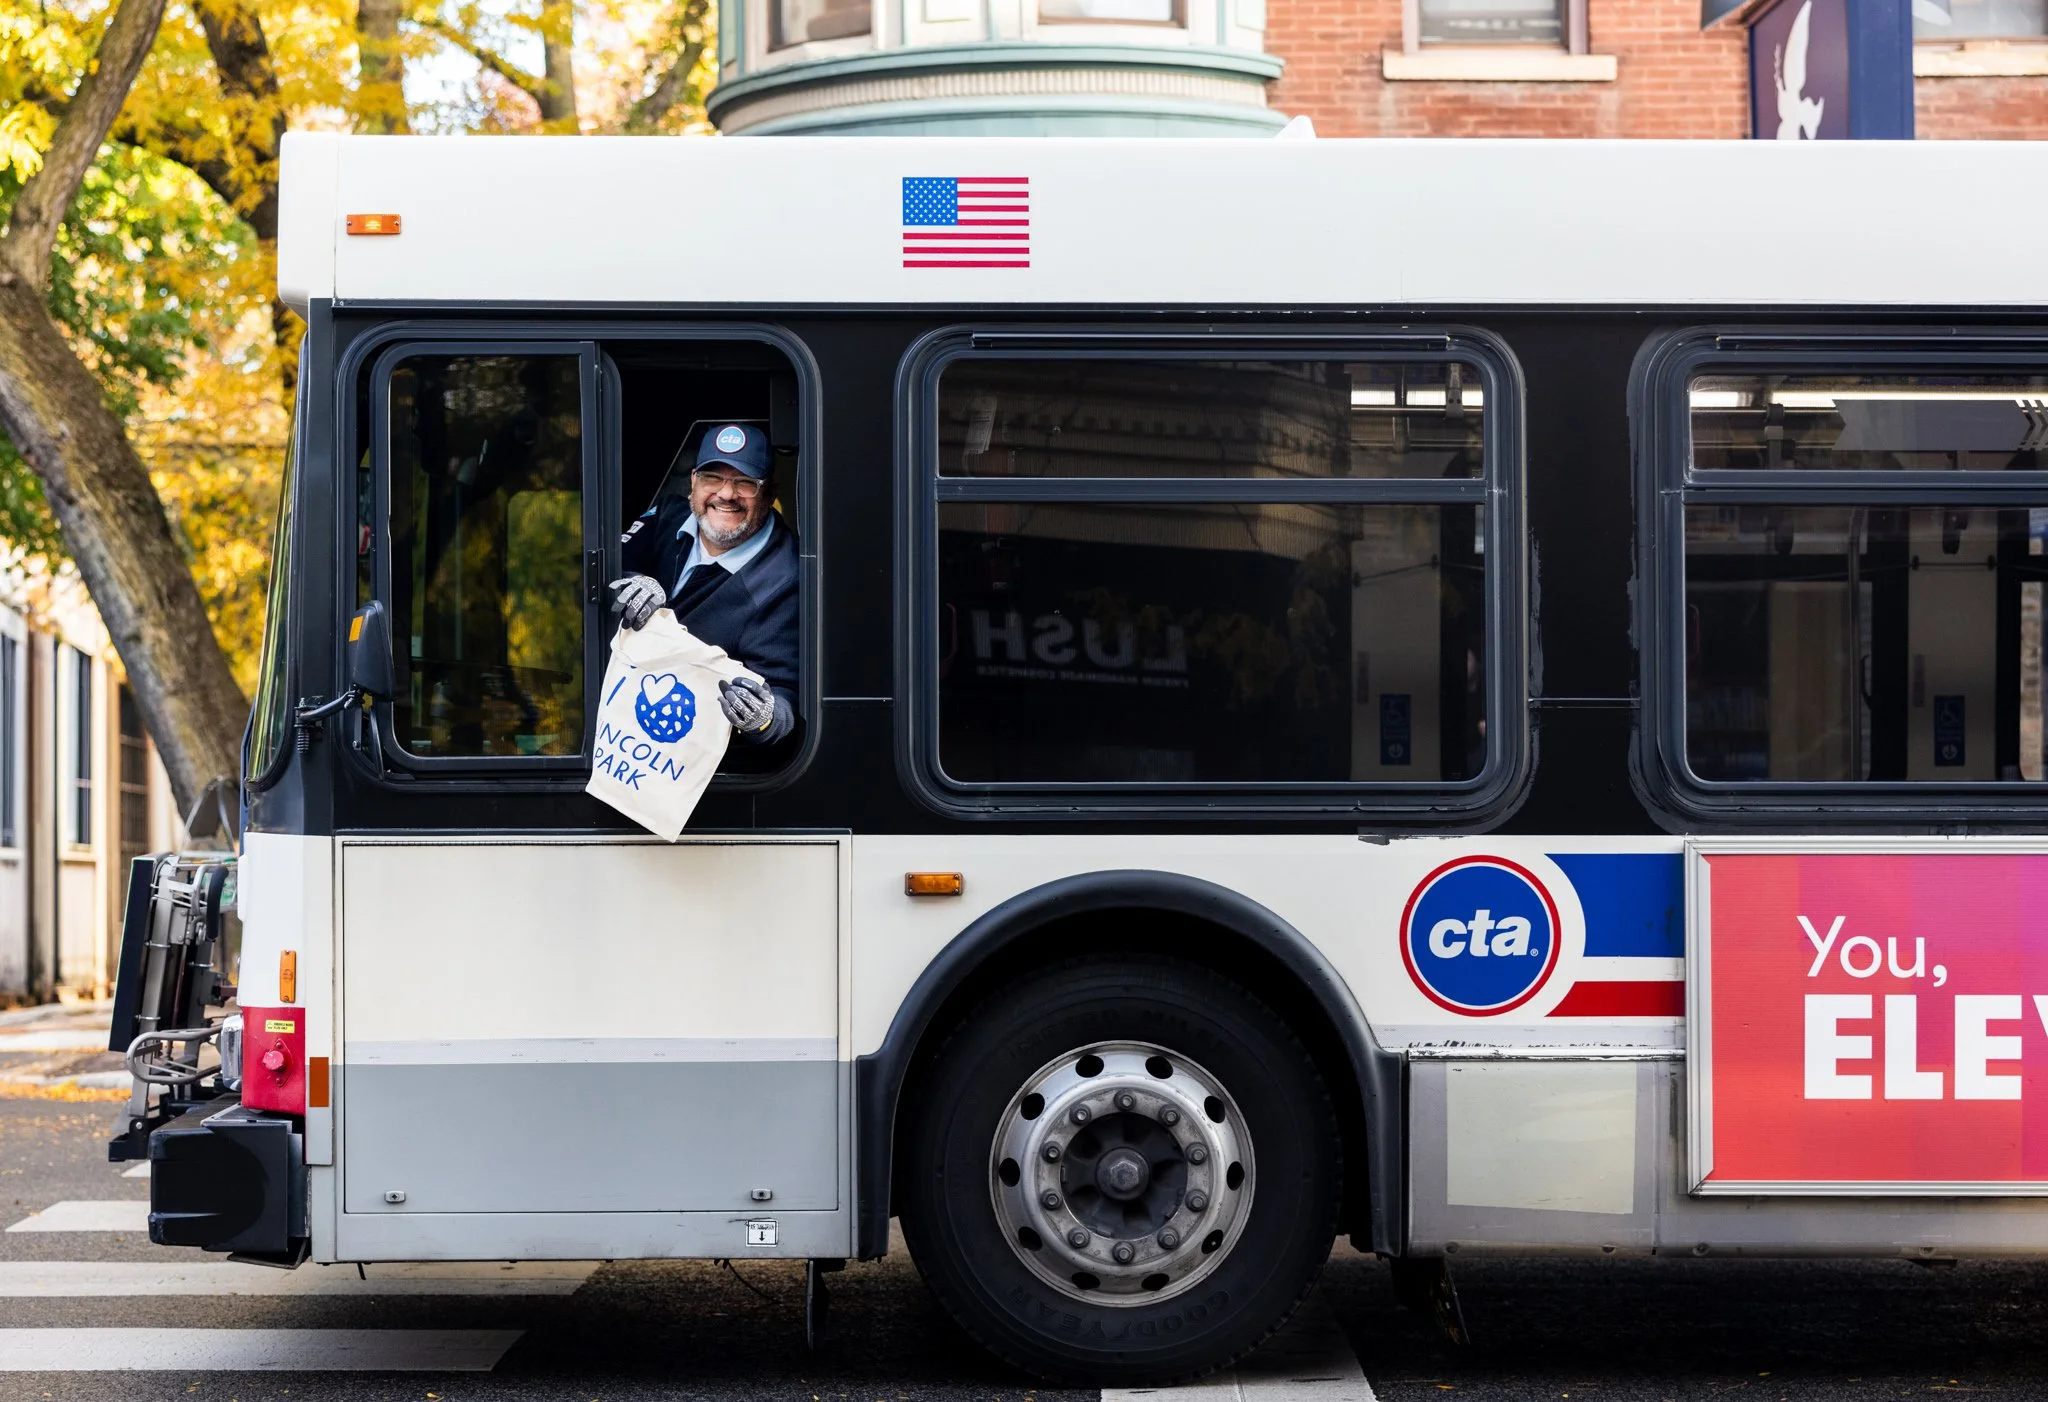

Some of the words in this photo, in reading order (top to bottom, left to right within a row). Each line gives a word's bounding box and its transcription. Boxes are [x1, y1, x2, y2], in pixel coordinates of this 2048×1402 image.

[720, 434, 741, 444] cta
[606, 676, 627, 706] I
[593, 747, 647, 790] PARK
[1428, 909, 1532, 959] cta
[1796, 915, 1948, 988] You,
[1804, 993, 2048, 1100] ELE
